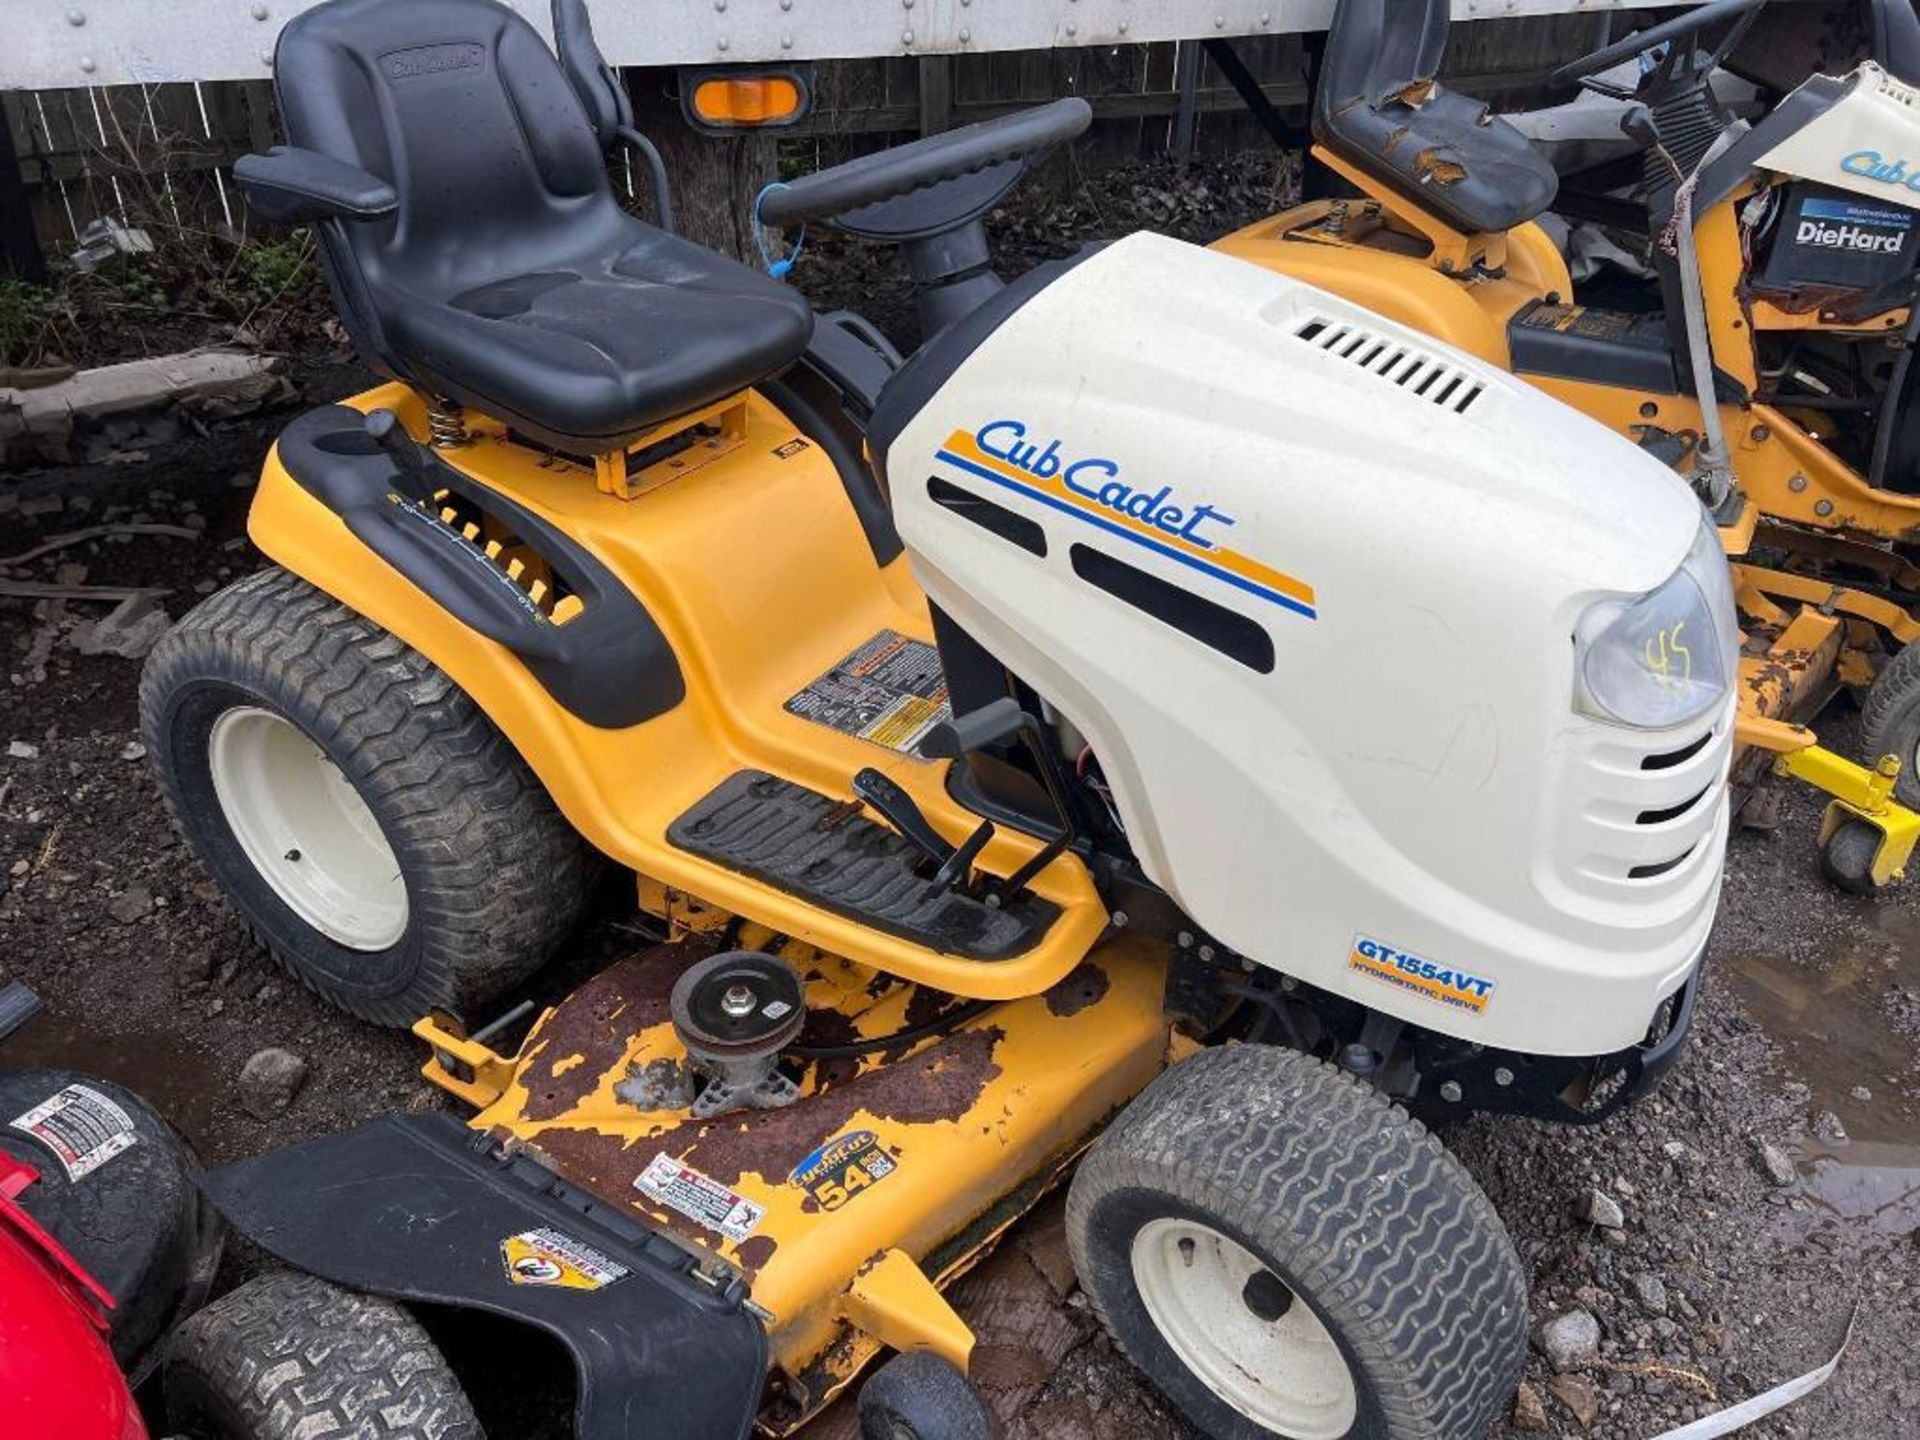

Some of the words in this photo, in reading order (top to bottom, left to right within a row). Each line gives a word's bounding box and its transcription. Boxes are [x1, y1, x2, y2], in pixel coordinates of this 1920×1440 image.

[1841, 151, 1906, 184] Cub
[1796, 221, 1905, 252] DieHard
[976, 420, 1062, 478] Cub
[1063, 458, 1236, 549] Cadet
[1646, 621, 1691, 698] 45
[1353, 961, 1438, 1000] HYDROSTATIC
[1441, 993, 1481, 1013] DRIVE
[1357, 939, 1493, 997] GT1554VT
[814, 1163, 873, 1210] 54
[532, 1238, 602, 1277] DANGER
